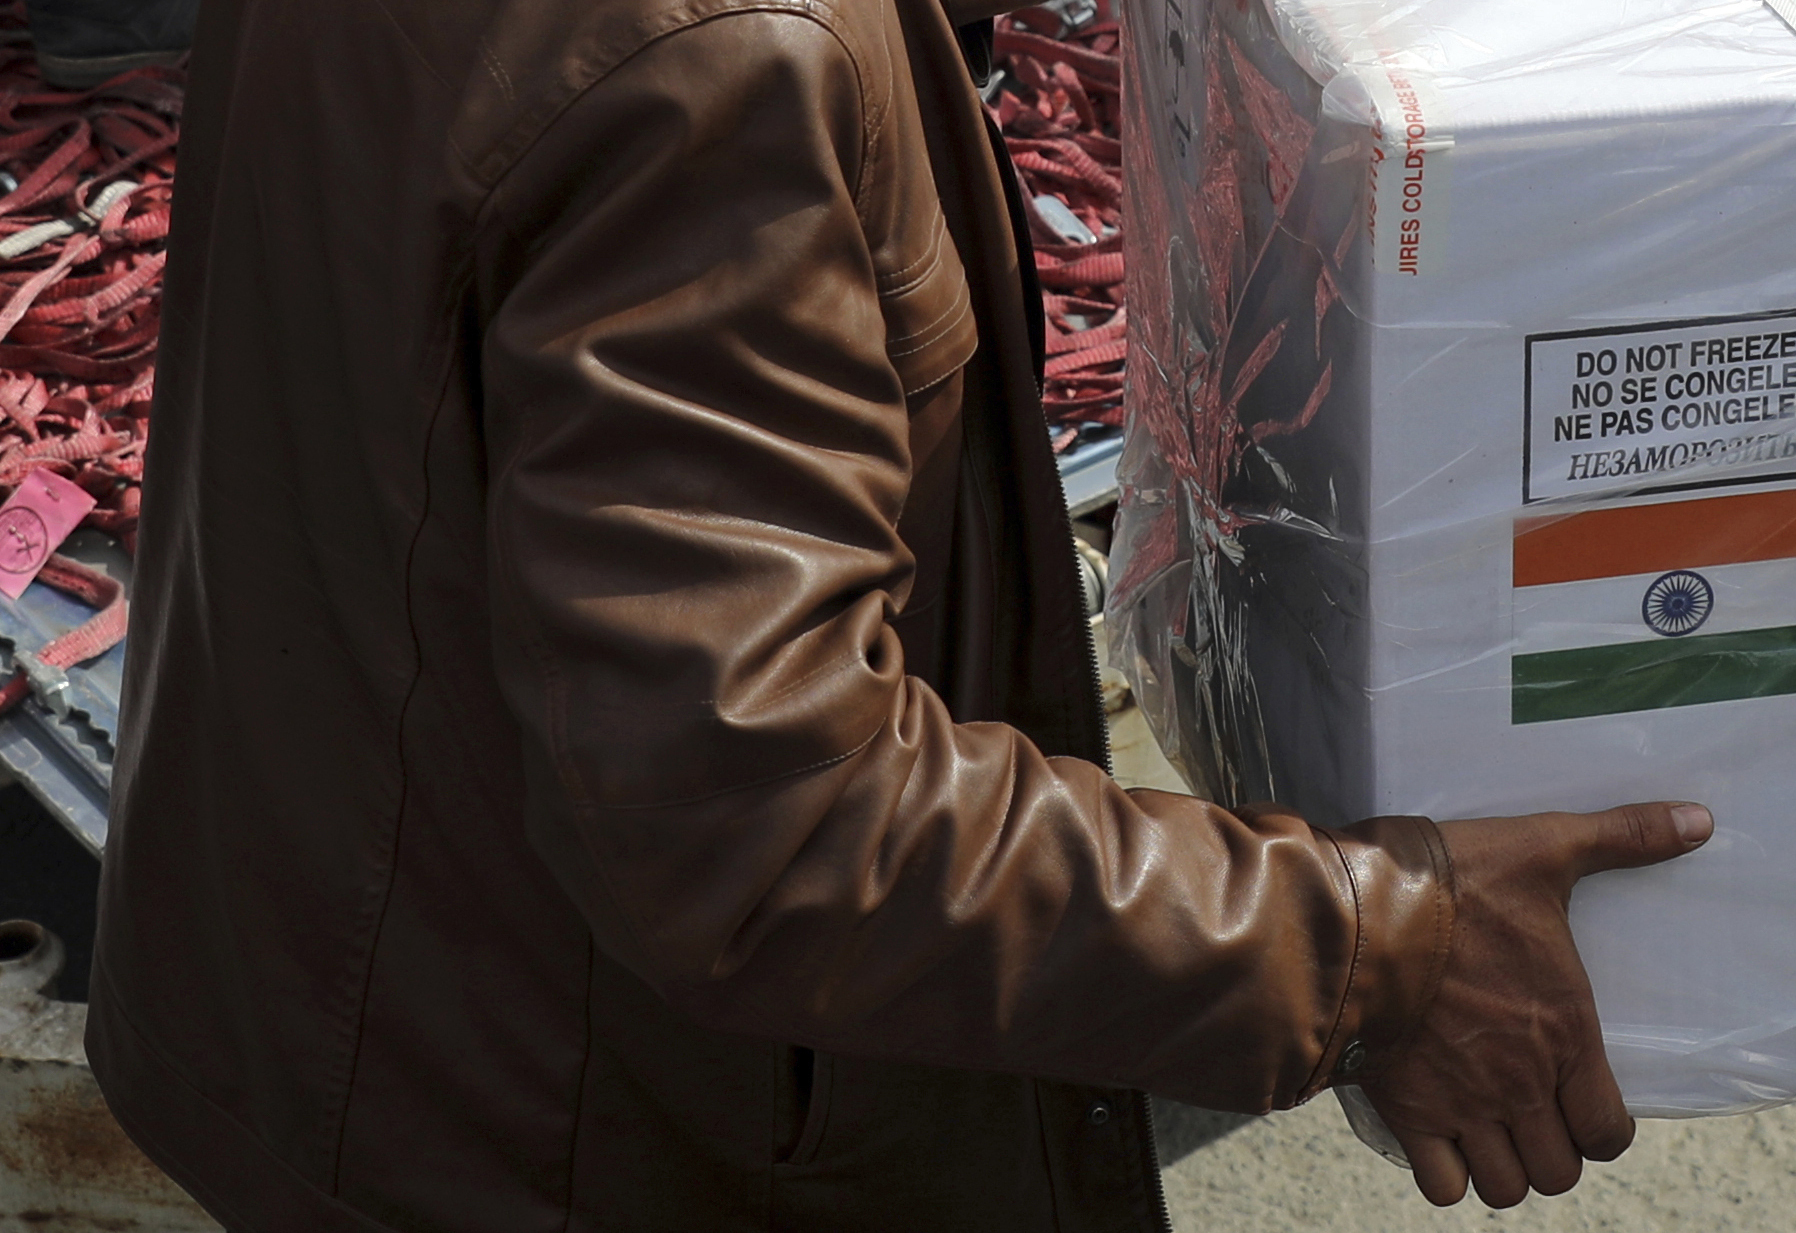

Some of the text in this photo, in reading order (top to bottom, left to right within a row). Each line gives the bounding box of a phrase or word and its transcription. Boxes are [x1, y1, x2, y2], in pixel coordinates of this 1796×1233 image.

[1402, 150, 1423, 214] COLD
[1576, 349, 1617, 378] DO
[1625, 343, 1682, 374] NOT
[1572, 380, 1613, 409] NO
[1620, 376, 1657, 405] SE
[1554, 415, 1592, 442] NE
[1600, 407, 1654, 438] PAS
